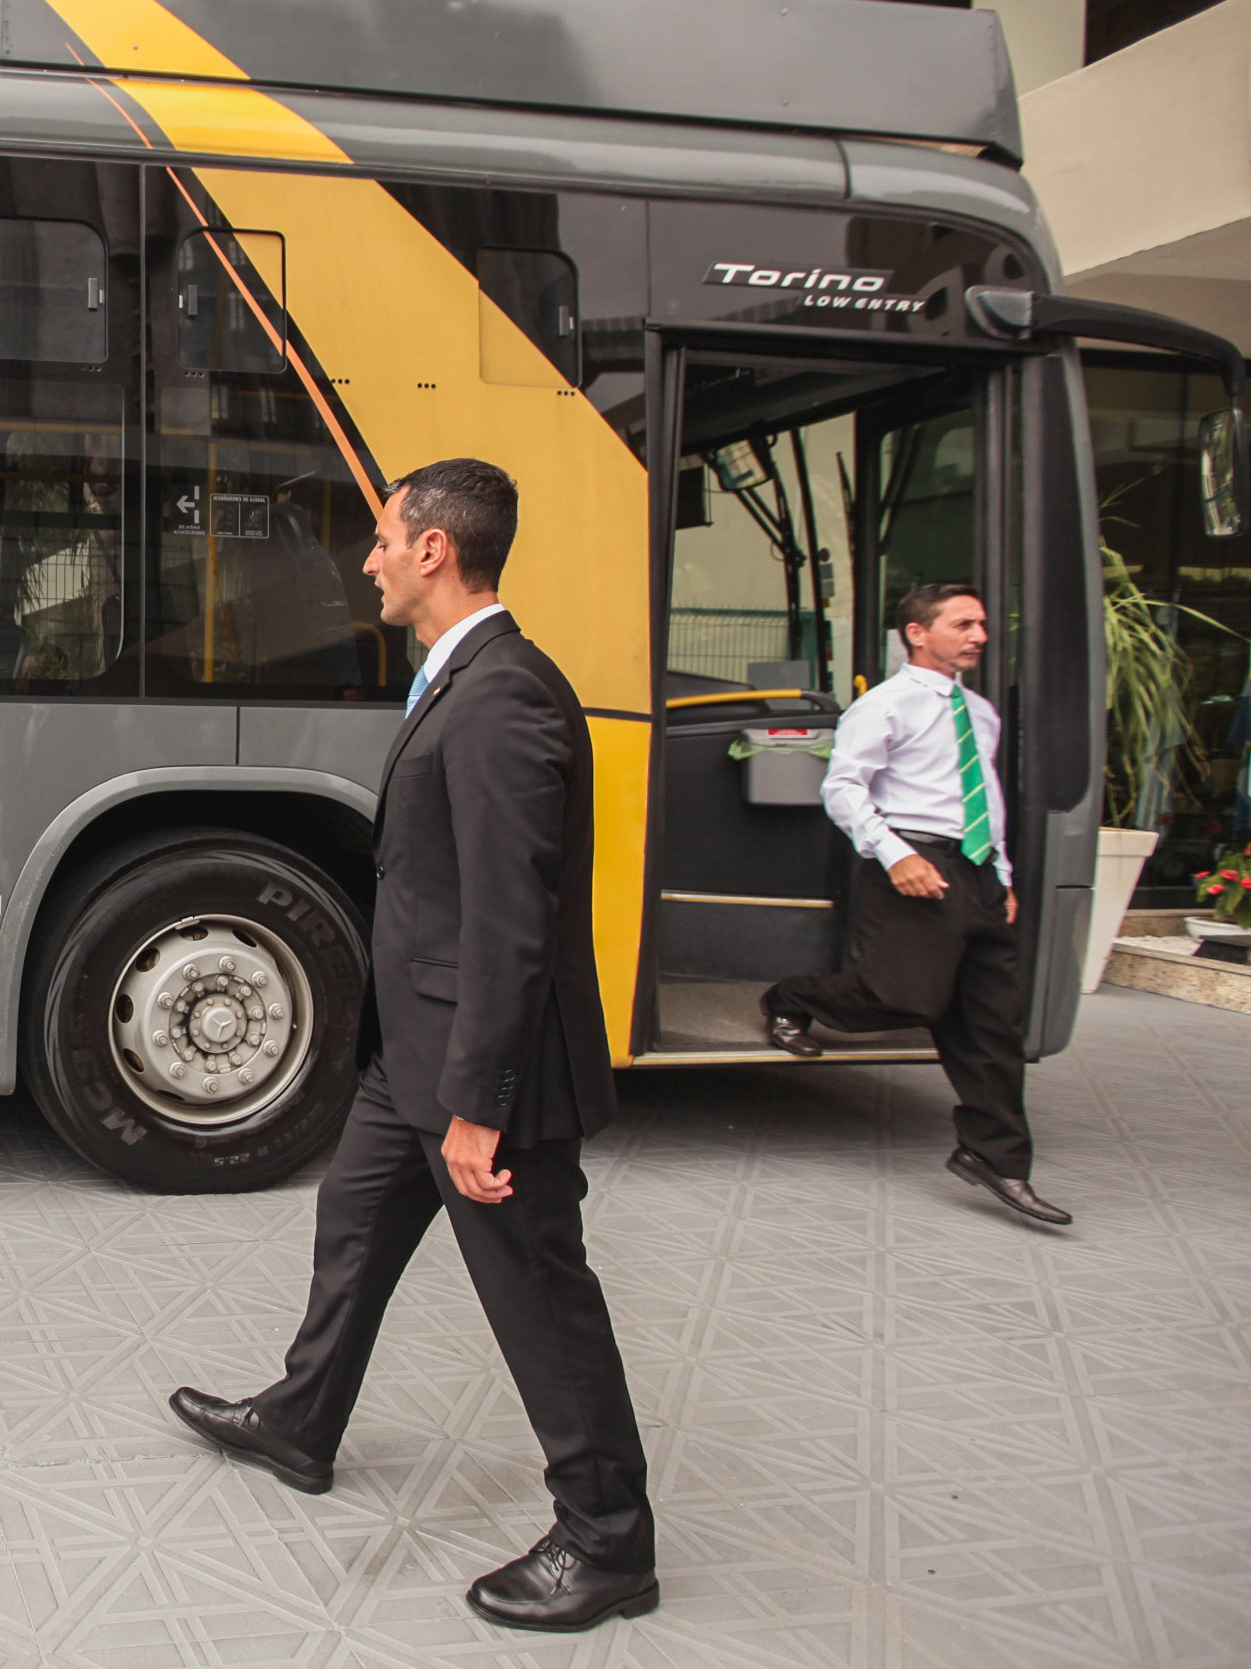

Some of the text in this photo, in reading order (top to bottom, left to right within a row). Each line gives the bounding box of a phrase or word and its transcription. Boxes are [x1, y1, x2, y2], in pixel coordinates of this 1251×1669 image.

[713, 263, 885, 292] Torino
[803, 294, 926, 312] LOW ENTRY
